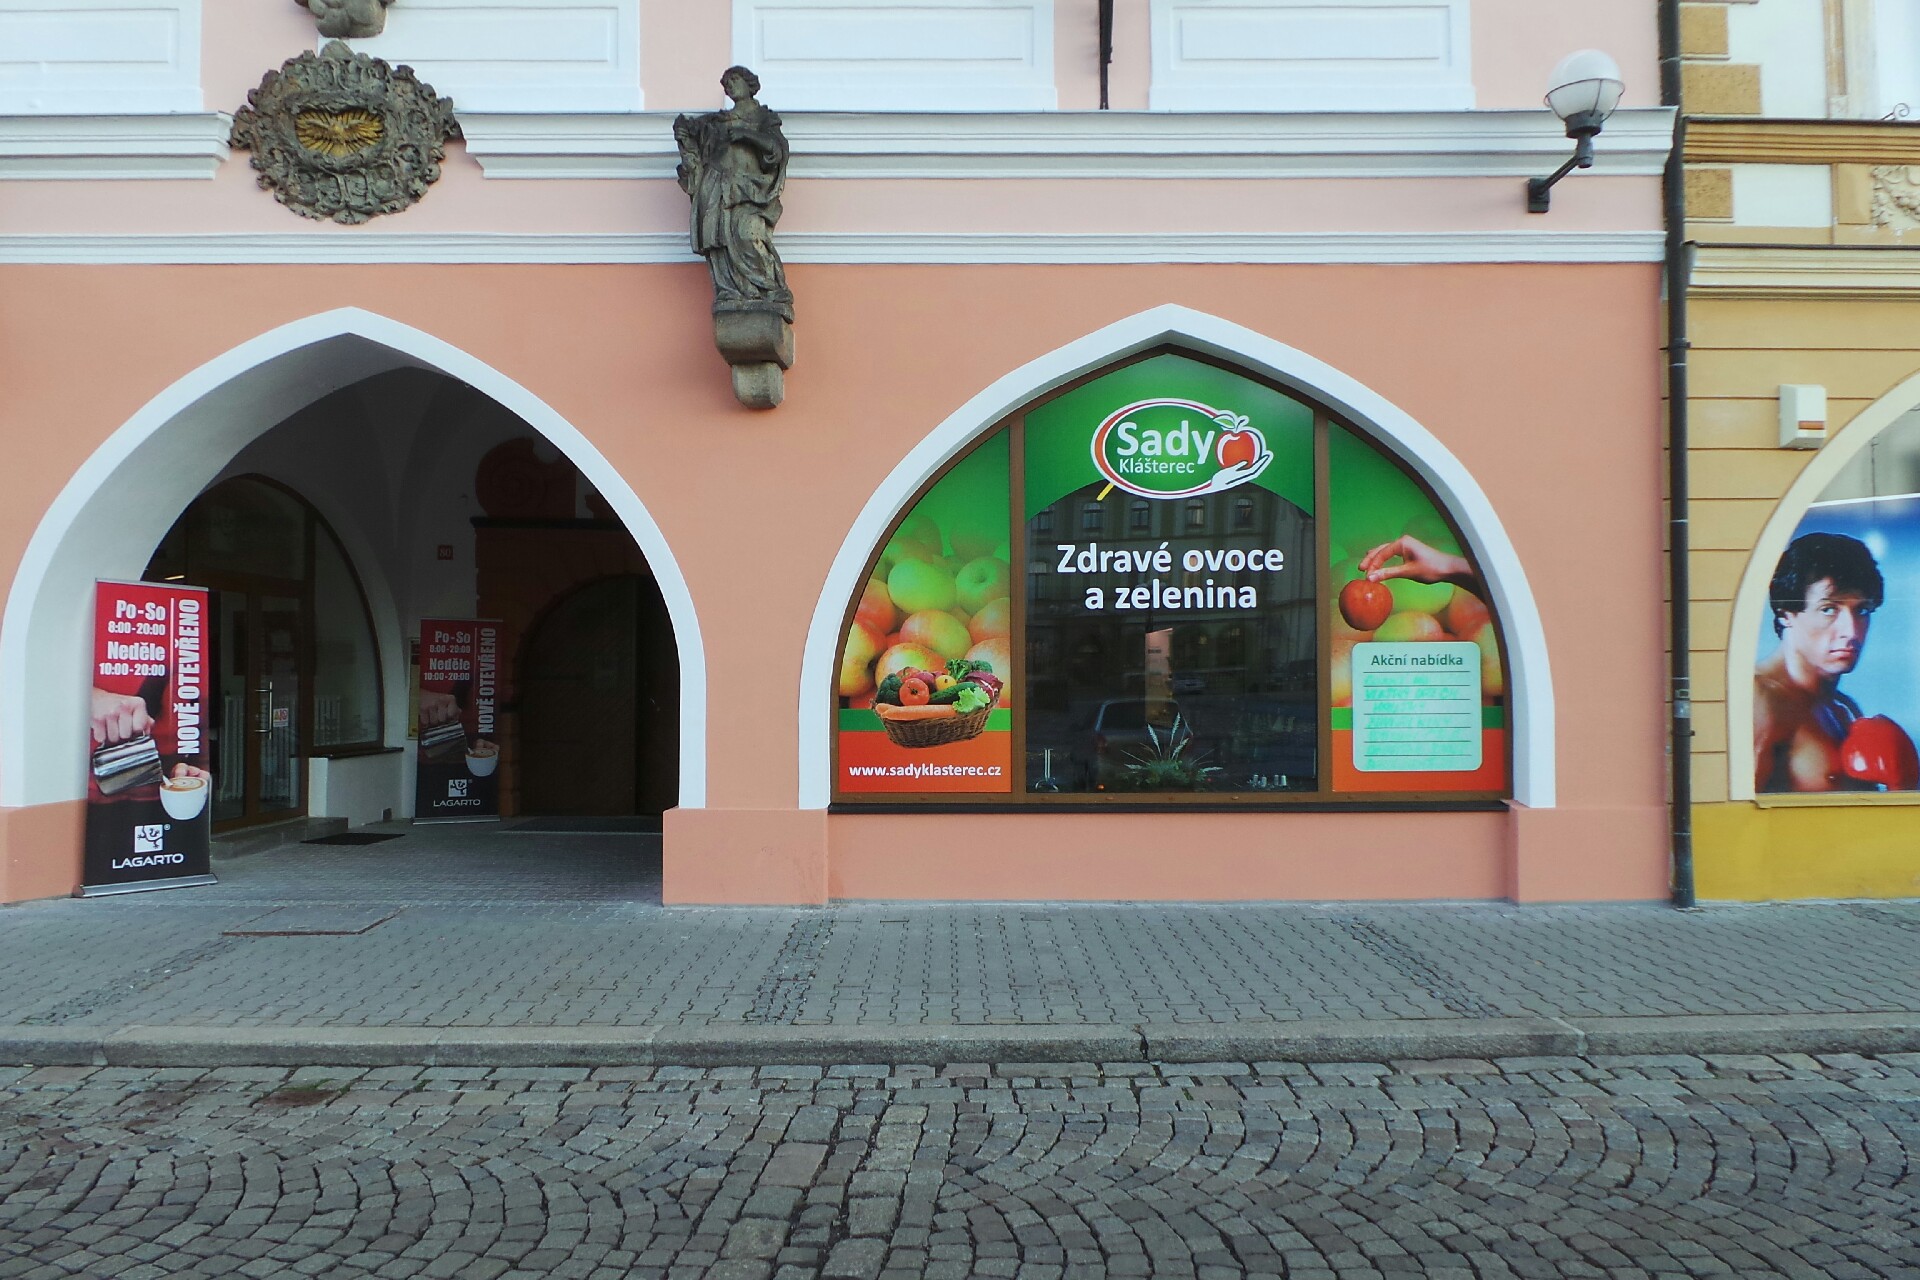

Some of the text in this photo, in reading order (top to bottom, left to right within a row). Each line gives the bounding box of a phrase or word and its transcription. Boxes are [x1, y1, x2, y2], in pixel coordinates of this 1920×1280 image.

[1116, 420, 1215, 465] Sady
[1119, 457, 1195, 474] Klášterec
[1056, 541, 1284, 573] Zdravé ovoce
[1085, 579, 1257, 609] a zelenina
[107, 641, 166, 661] Neděle
[1371, 654, 1463, 666] Akční nabídka
[429, 658, 471, 671] Neděle
[173, 599, 200, 754] NOVĚ OTEVŘENO
[476, 628, 497, 733] NOVĚ OTEVŘENO
[849, 763, 1002, 779] www.sadyklasterec.cz
[433, 798, 481, 807] LAGARTO
[112, 853, 184, 869] LAGARTO
